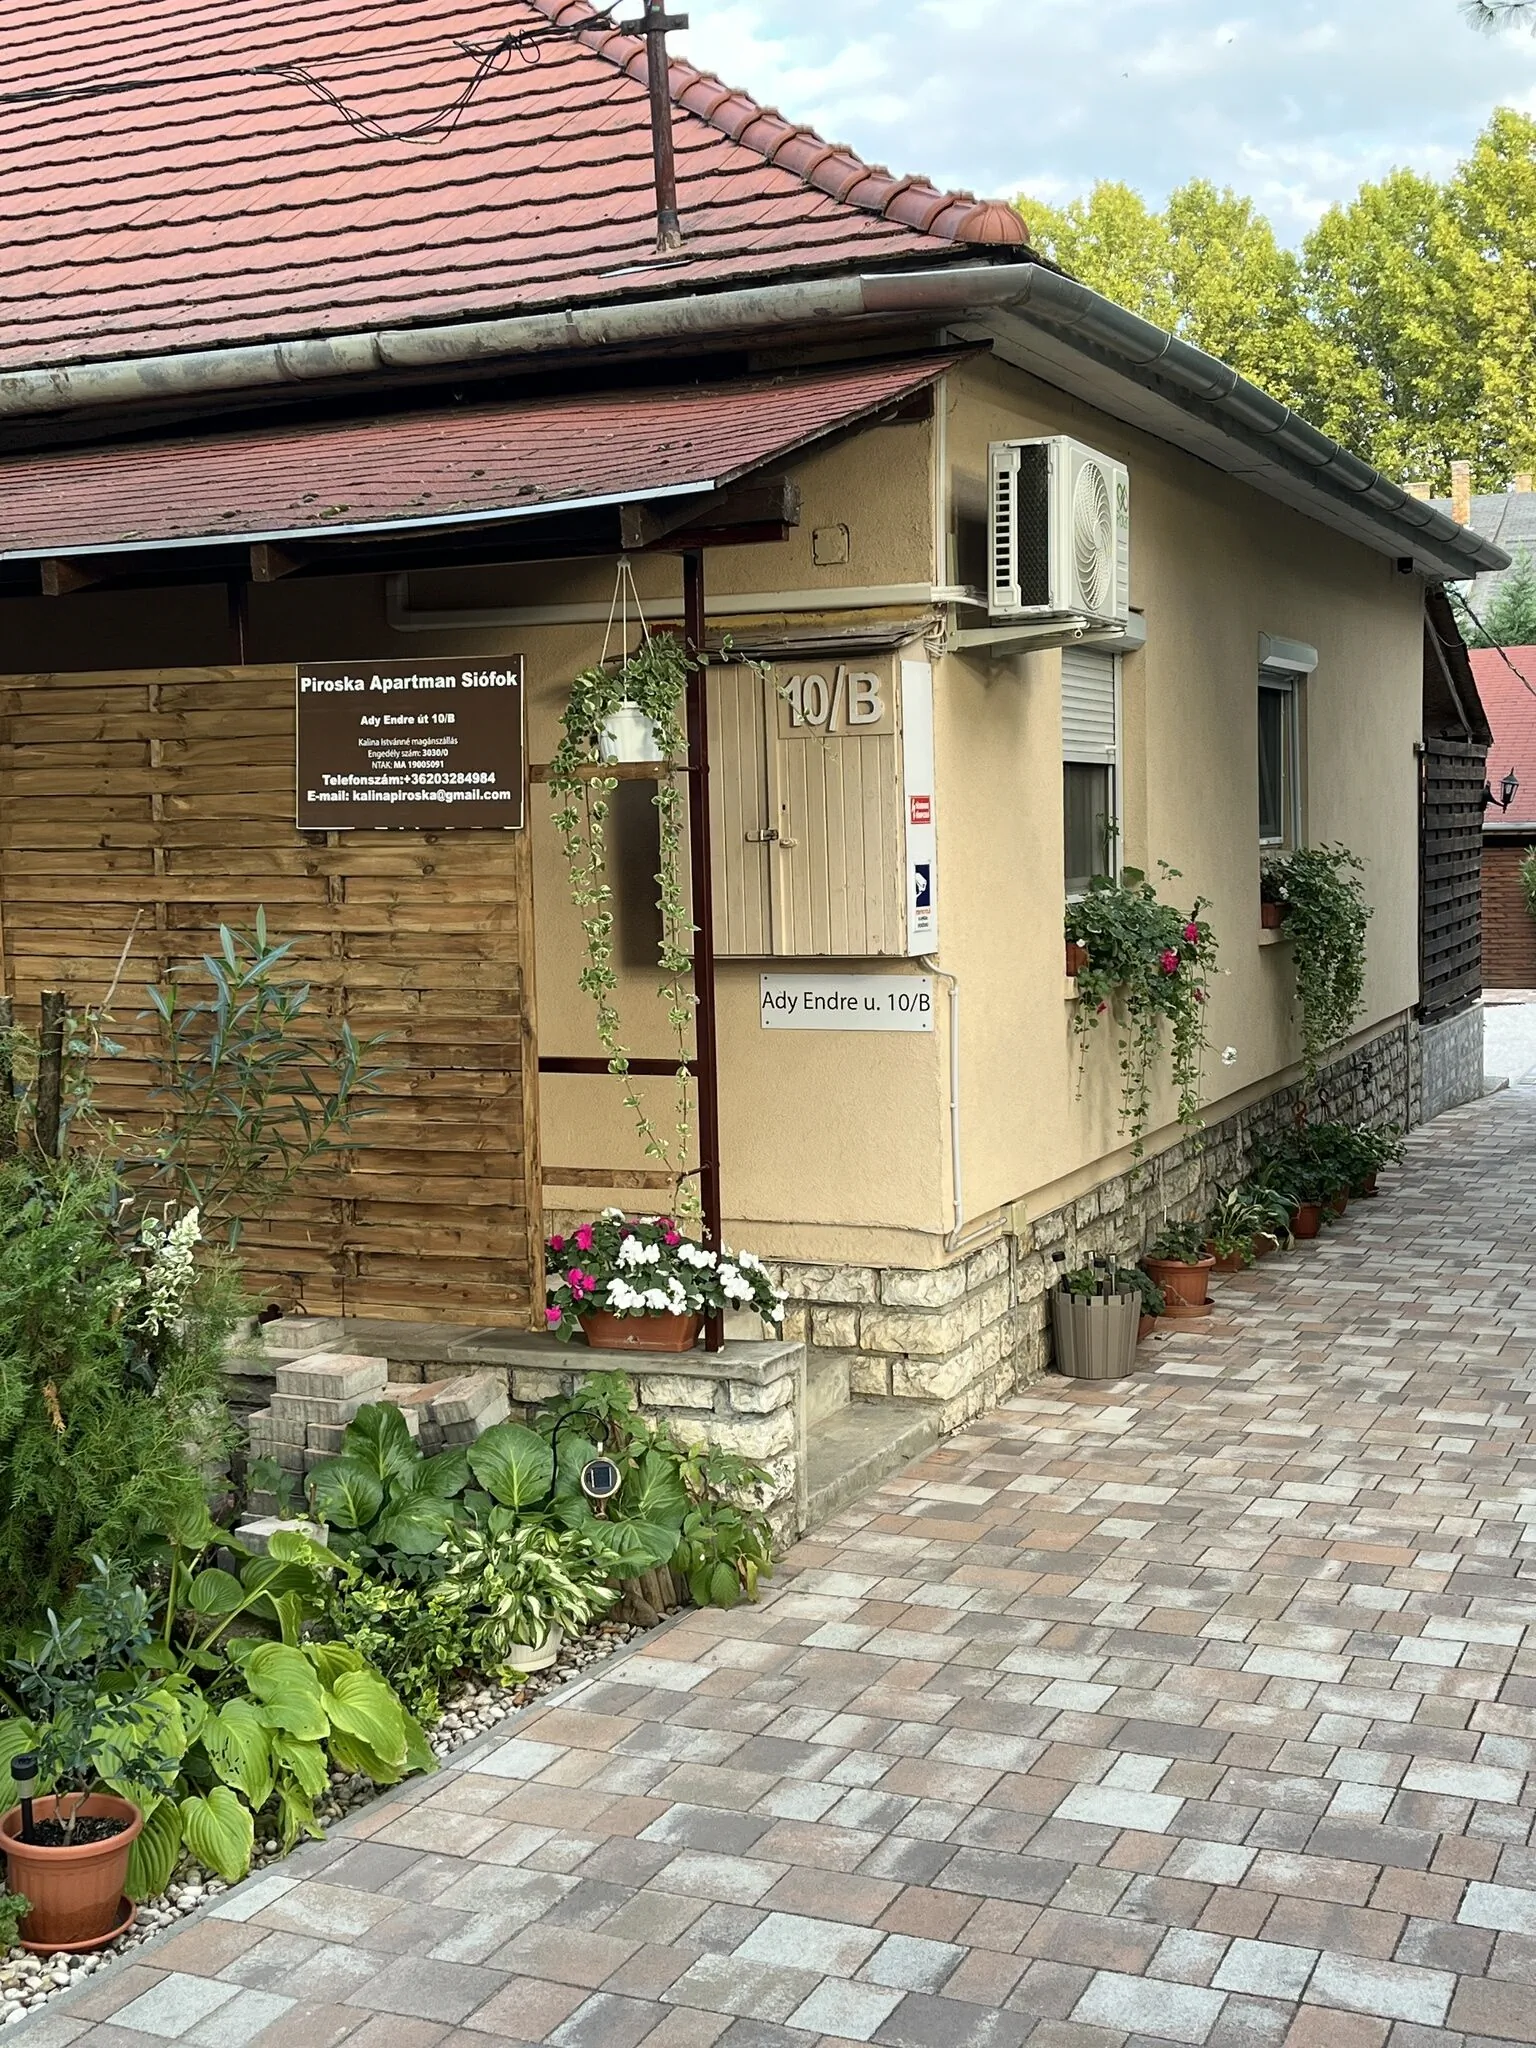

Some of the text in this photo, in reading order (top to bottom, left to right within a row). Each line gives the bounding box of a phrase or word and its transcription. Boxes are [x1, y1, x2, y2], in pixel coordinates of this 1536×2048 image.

[300, 670, 518, 693] Piroska Apartman Siófok
[783, 664, 886, 732] 10/B
[360, 713, 455, 727] Ady Endre út 10/B
[358, 738, 380, 747] Kalina
[367, 749, 400, 759] Engedély
[408, 760, 444, 768] 19005091
[322, 772, 496, 786] Telefonszám:+36203284984
[307, 788, 511, 804] E-mail: kalinapiroska@gmail.com
[762, 991, 931, 1014] Ady Endre u. 10/B
